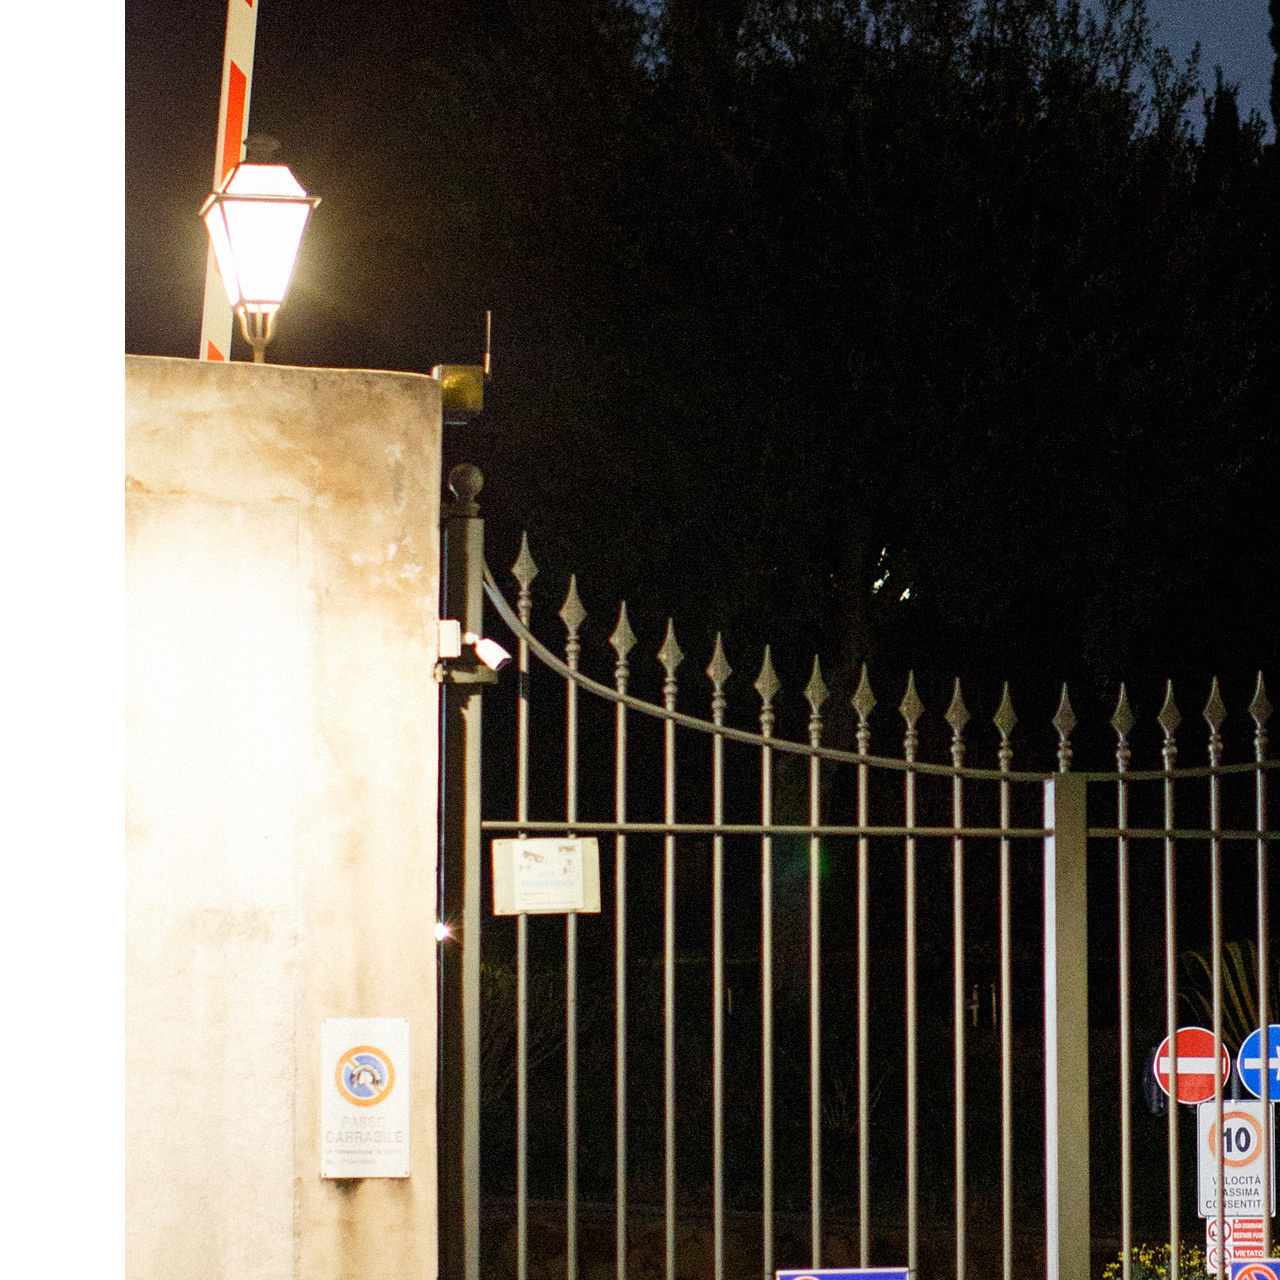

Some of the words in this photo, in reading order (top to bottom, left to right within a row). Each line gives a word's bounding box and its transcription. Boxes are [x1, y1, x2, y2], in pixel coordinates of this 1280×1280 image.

[342, 1116, 386, 1128] PASSO
[325, 1130, 404, 1144] CARRABILE
[1223, 1126, 1251, 1153] 10
[1212, 1174, 1262, 1185] VLOCITÀ
[1214, 1187, 1260, 1197] ASSIMA
[1234, 1249, 1264, 1257] VIETATO
